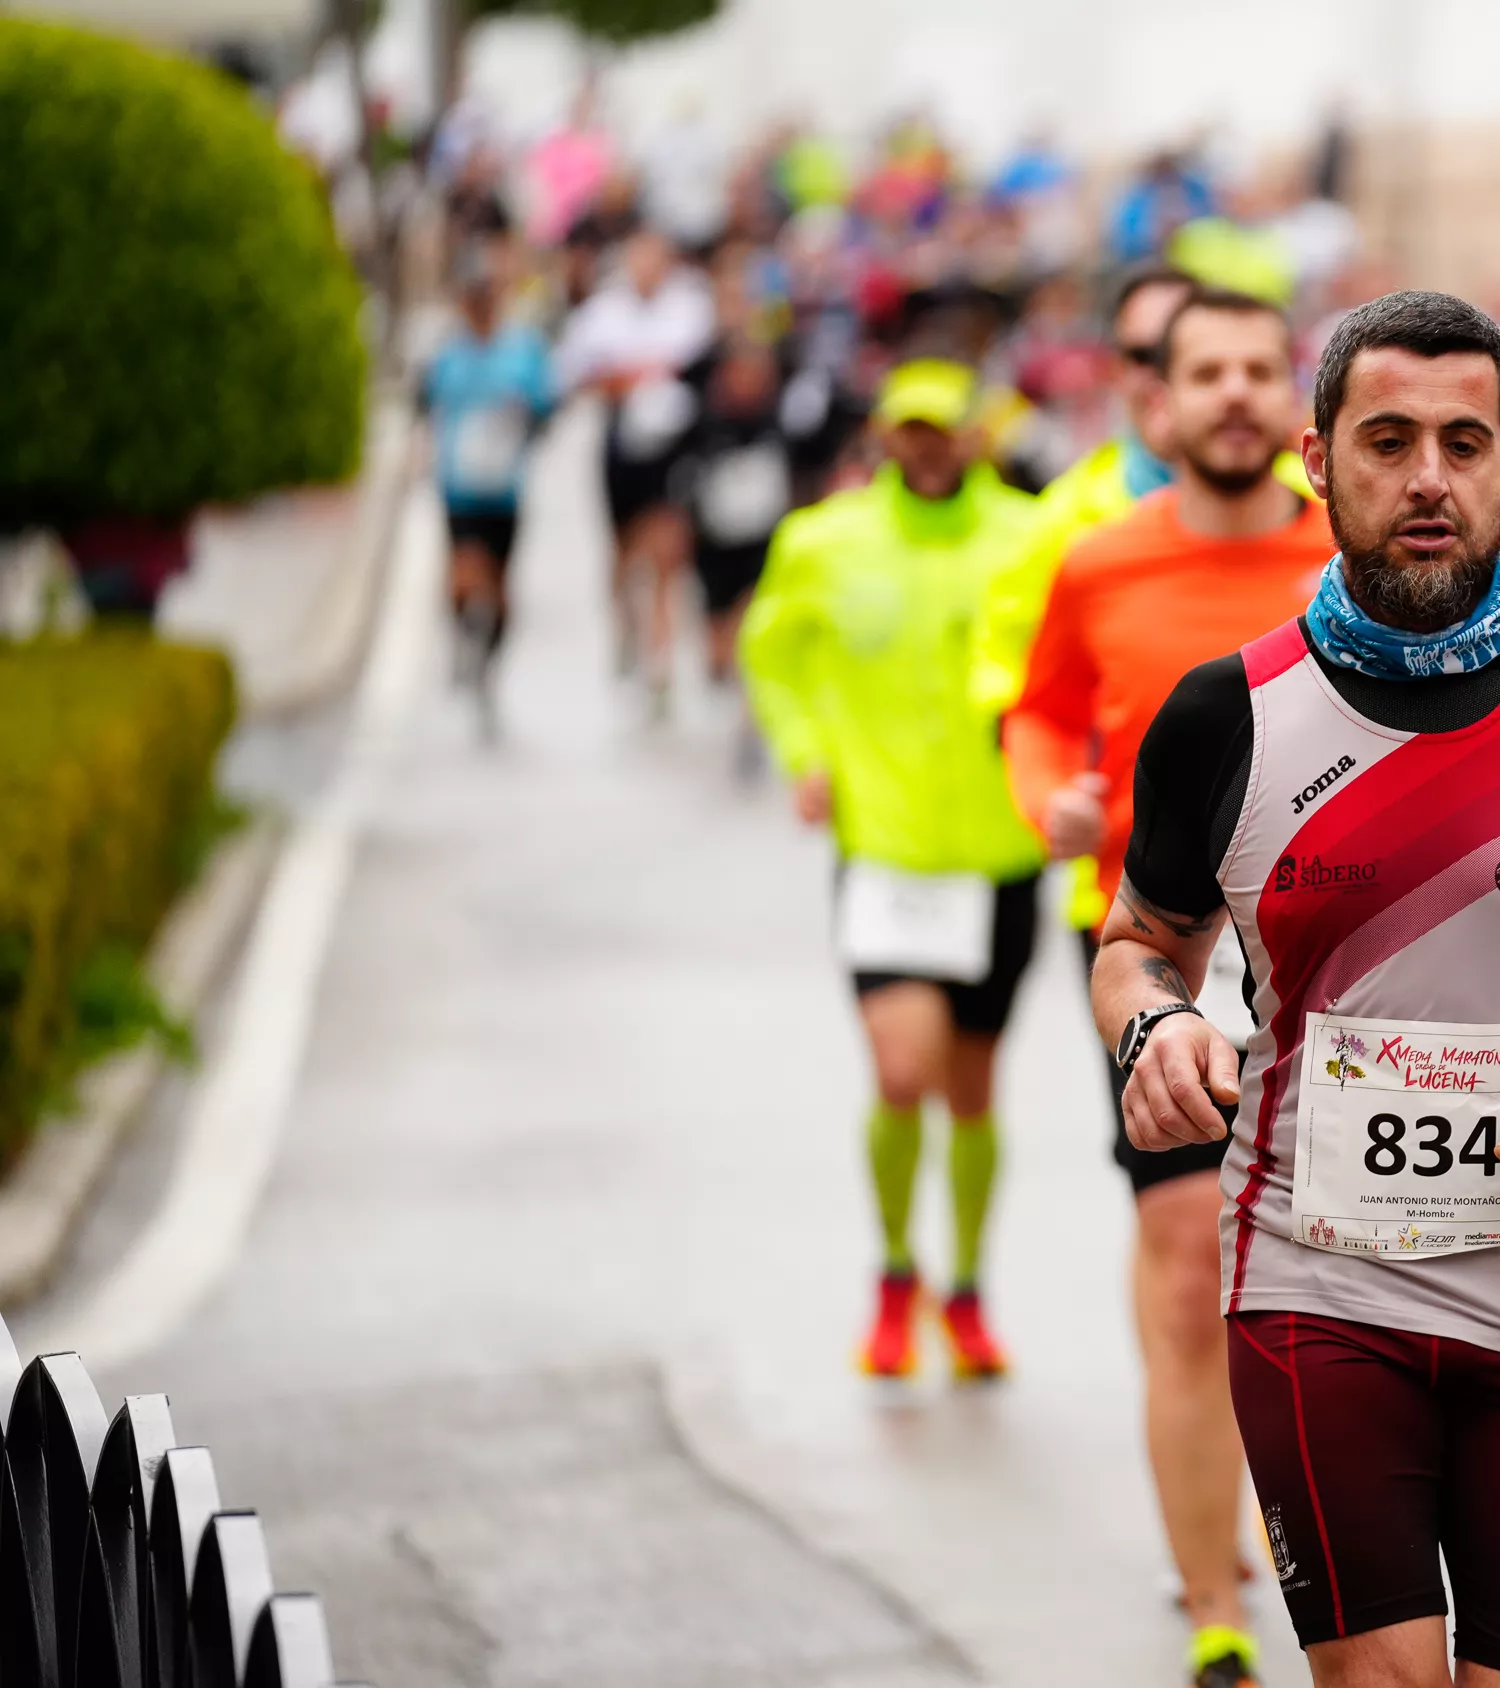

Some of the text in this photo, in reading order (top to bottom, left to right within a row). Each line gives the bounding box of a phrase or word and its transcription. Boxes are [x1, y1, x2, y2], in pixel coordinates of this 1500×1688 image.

[1301, 855, 1322, 871] LA
[1300, 863, 1376, 888] SIDERO
[1405, 1065, 1488, 1093] LUCENA
[1364, 1112, 1500, 1176] 834
[1360, 1195, 1383, 1204] JUAN
[1386, 1196, 1428, 1205] ANTONIO
[1431, 1197, 1451, 1205] RUIZ
[1407, 1210, 1455, 1218] M-Hombre
